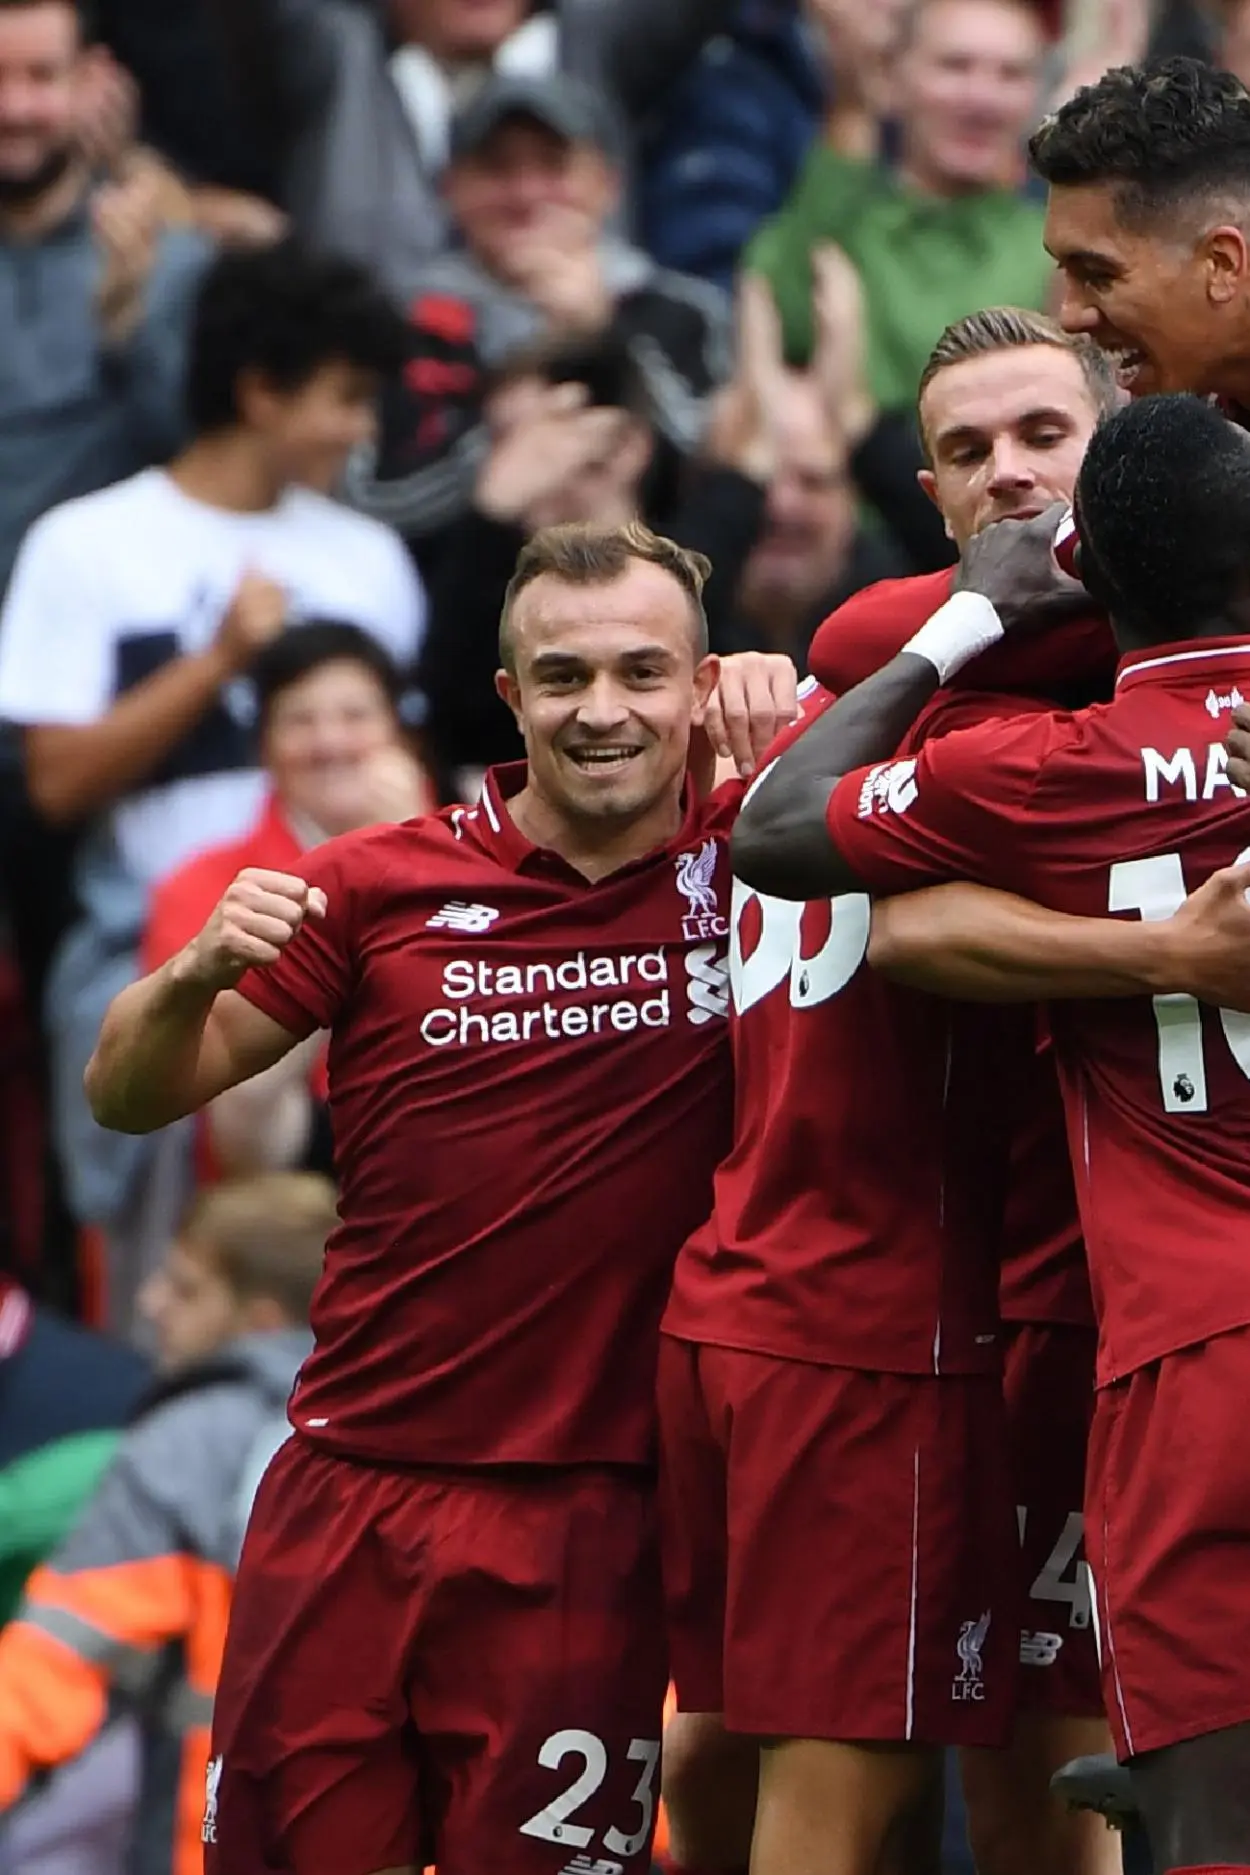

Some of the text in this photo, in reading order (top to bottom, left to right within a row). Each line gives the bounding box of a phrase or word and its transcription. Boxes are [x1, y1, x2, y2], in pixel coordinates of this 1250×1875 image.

[1140, 742, 1247, 802] MA
[442, 945, 668, 999] Standard
[419, 989, 670, 1046] Chartered
[1016, 1505, 1091, 1630] 4
[519, 1728, 660, 1857] 23
